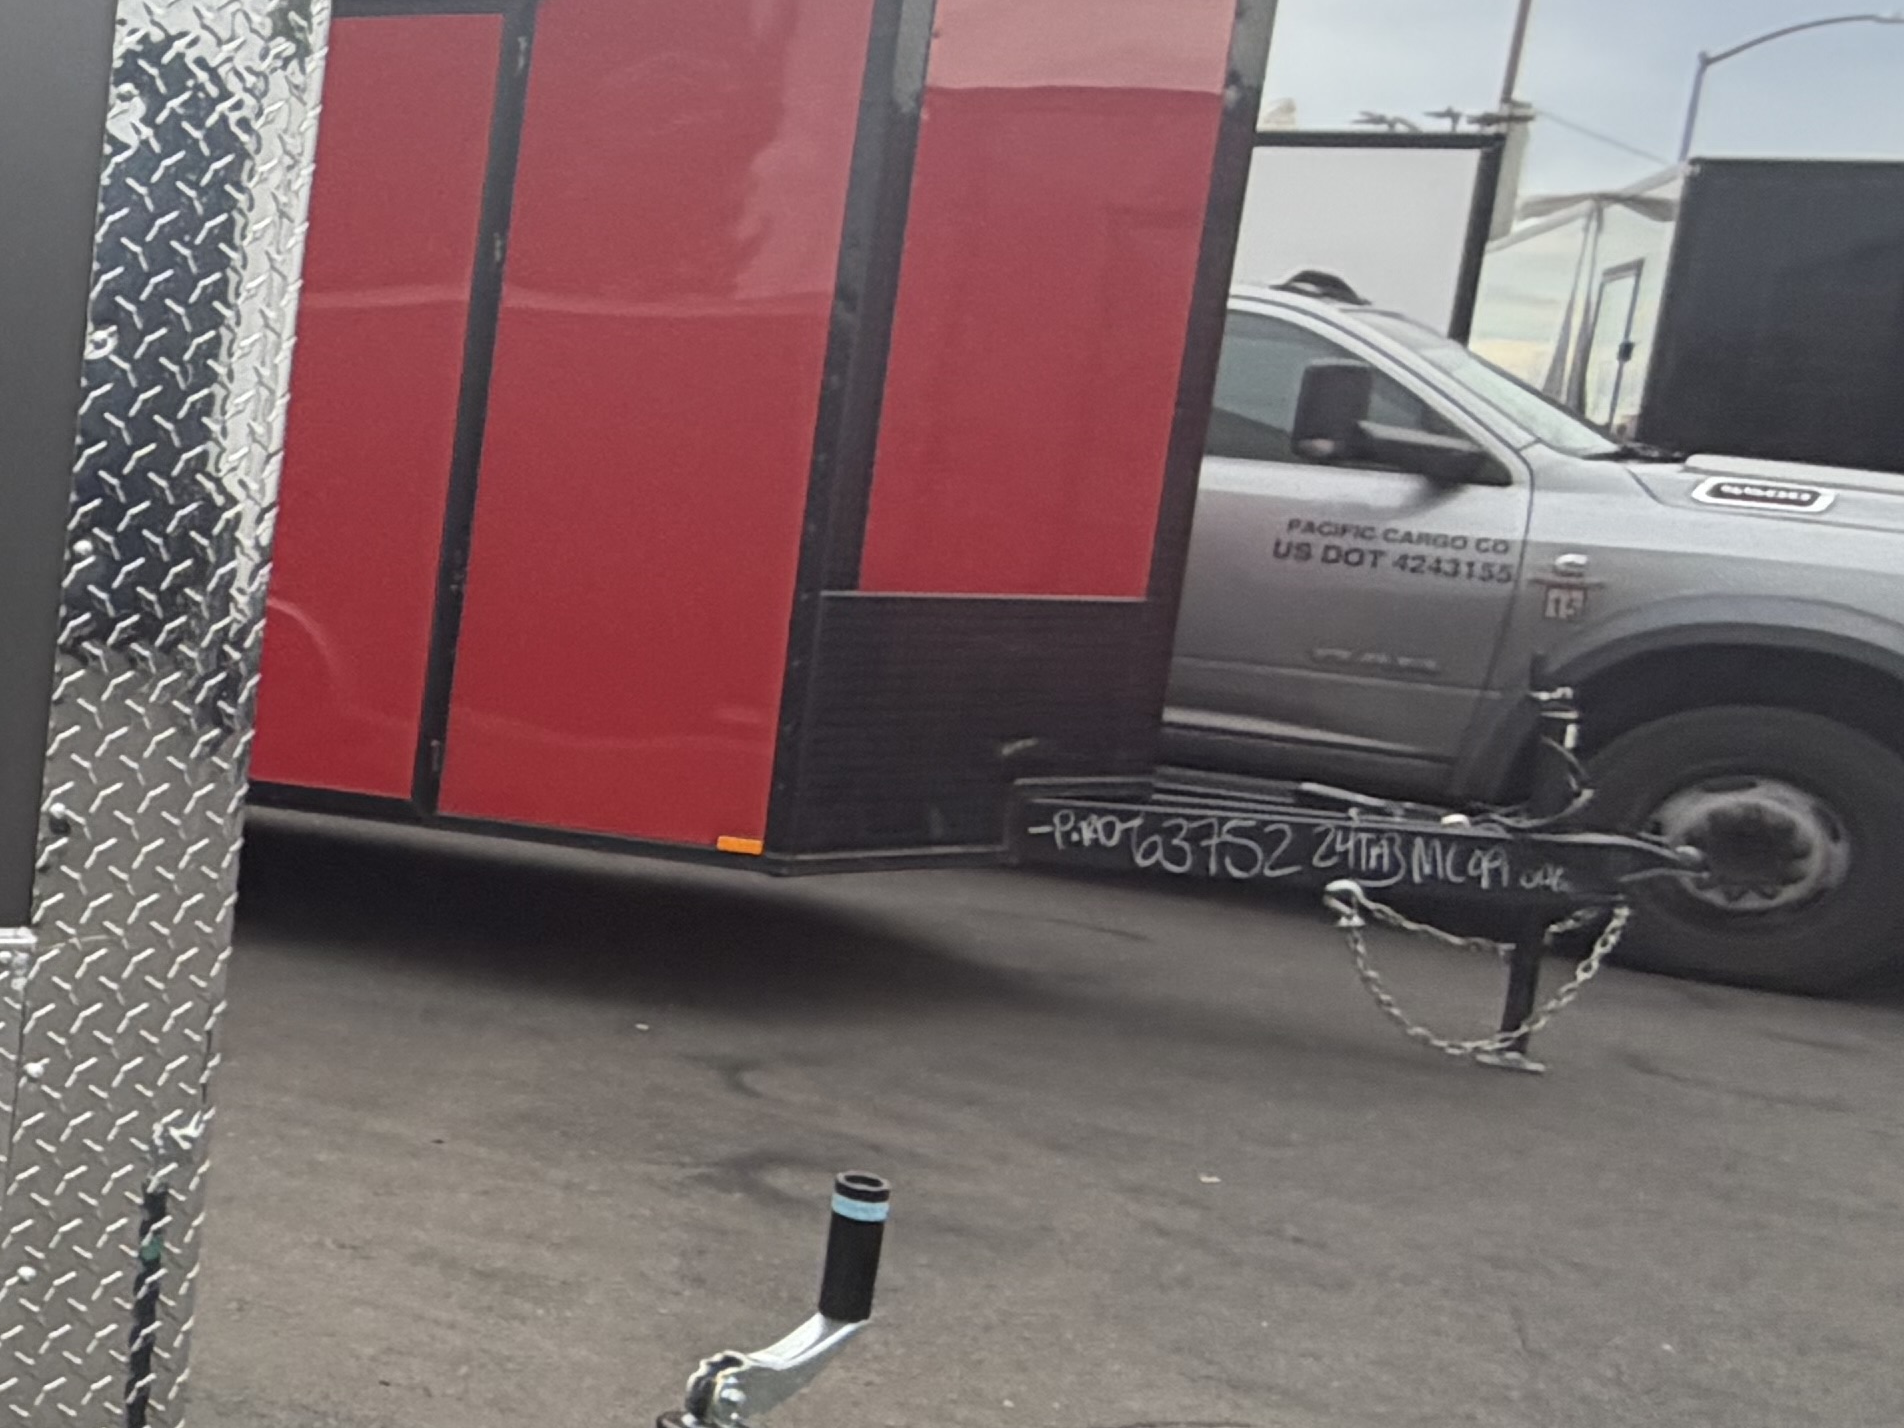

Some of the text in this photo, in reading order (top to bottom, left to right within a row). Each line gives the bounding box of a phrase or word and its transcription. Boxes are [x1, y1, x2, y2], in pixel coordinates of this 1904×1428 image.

[1286, 518, 1510, 556] PACIFIC CARGO CO
[1272, 537, 1514, 585] US DOT 4243155
